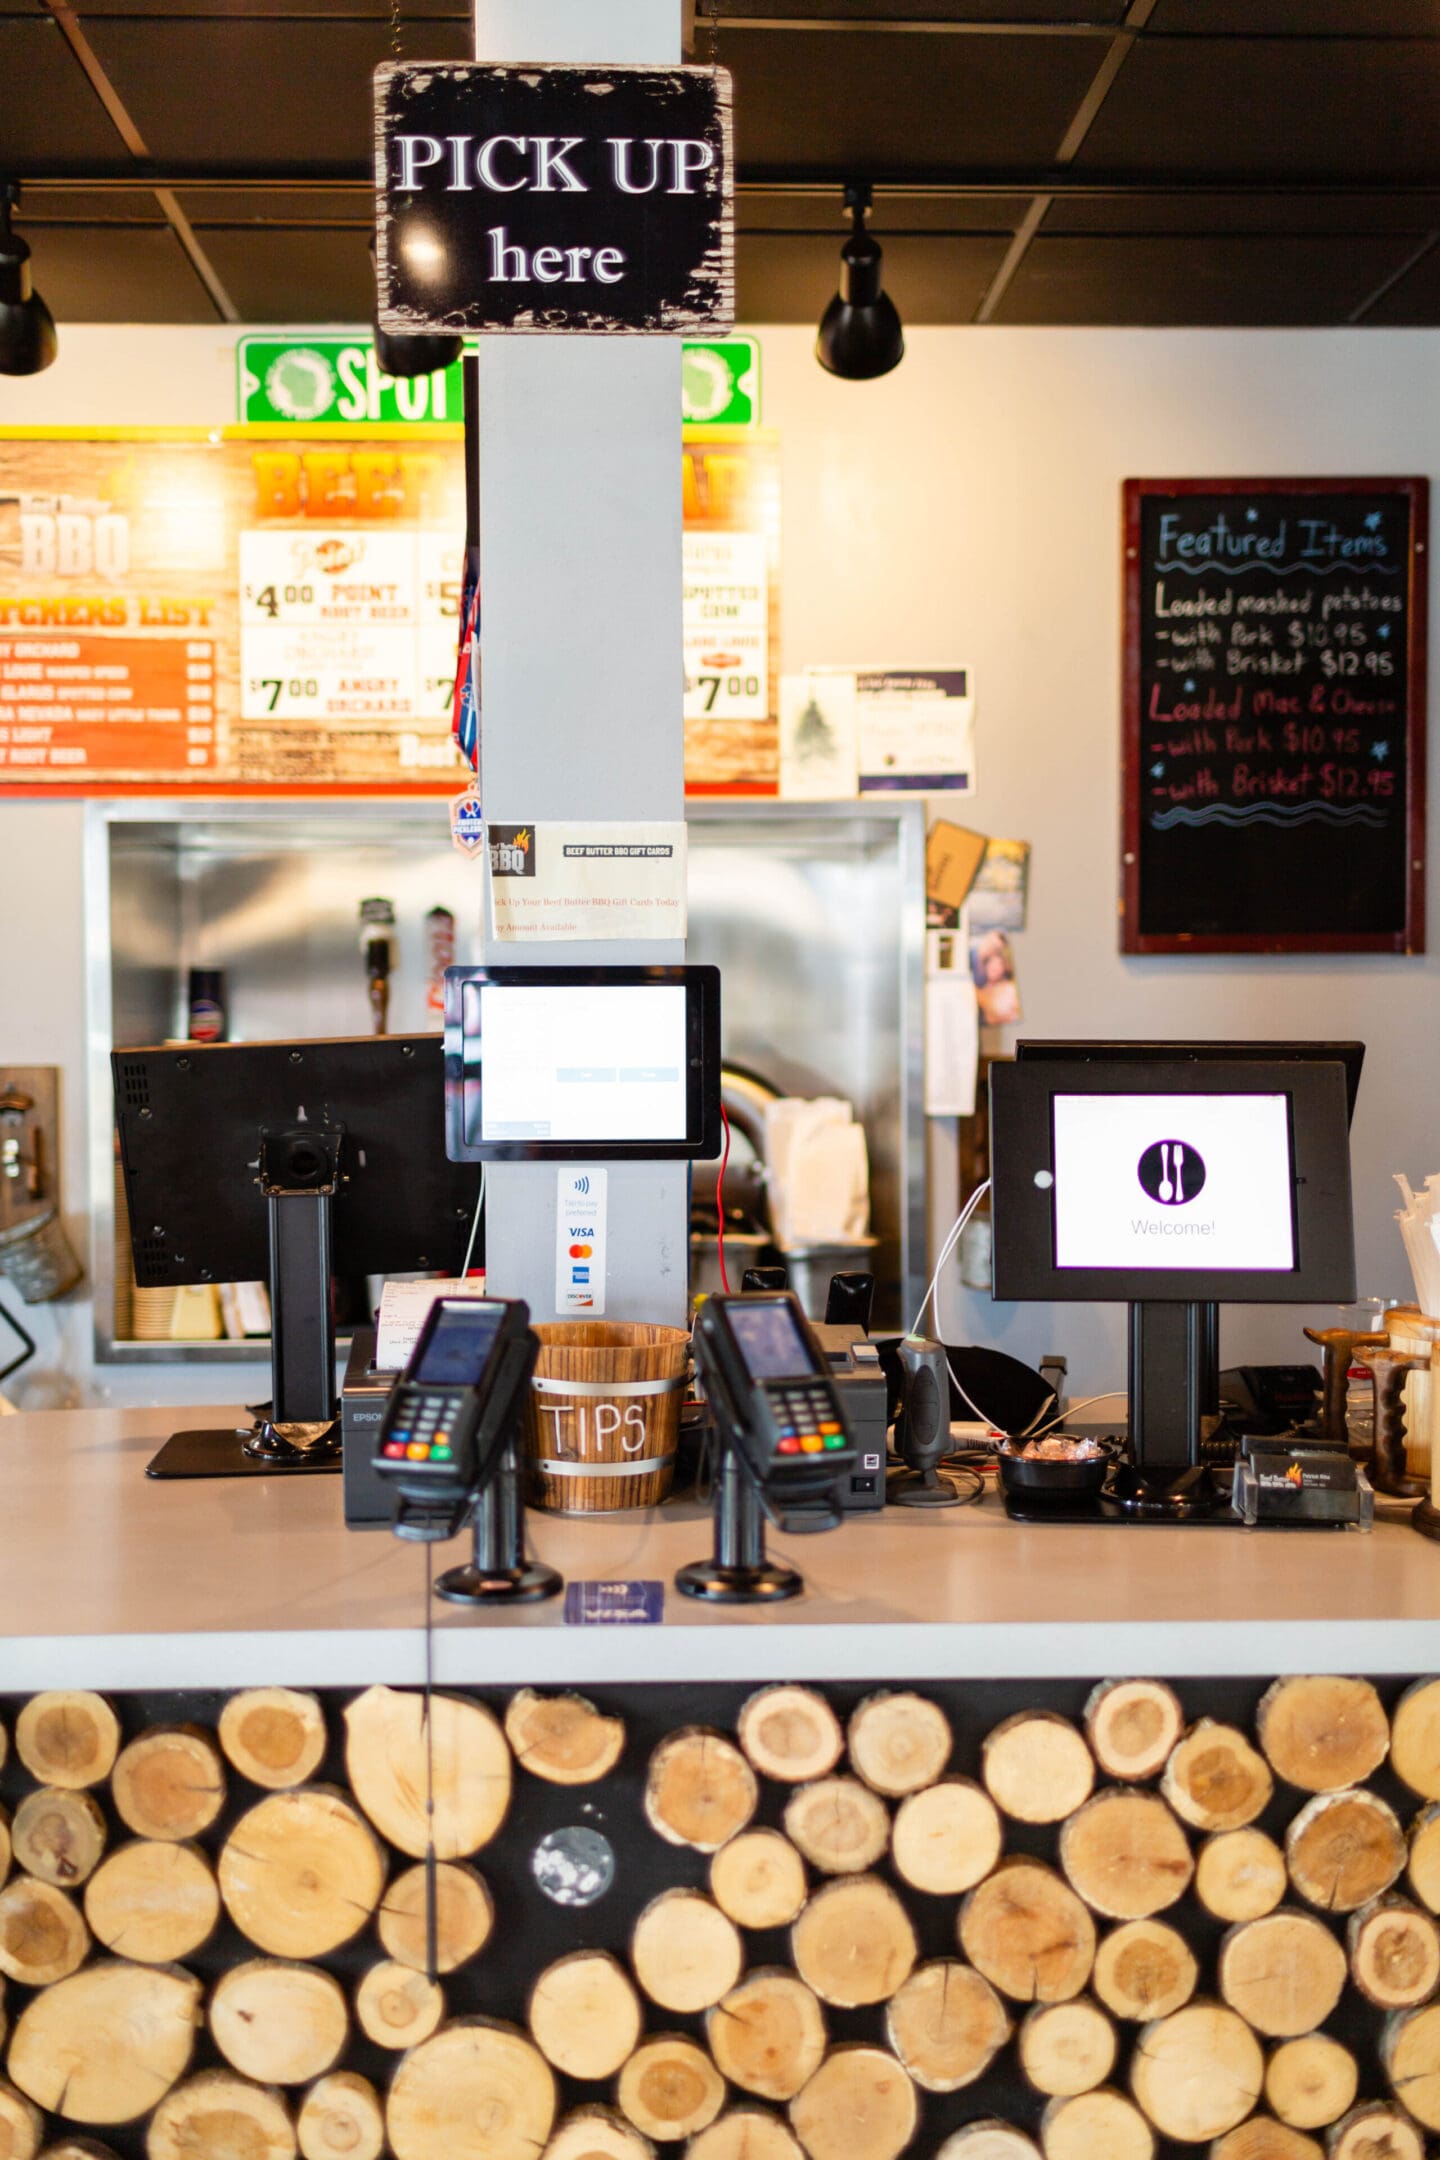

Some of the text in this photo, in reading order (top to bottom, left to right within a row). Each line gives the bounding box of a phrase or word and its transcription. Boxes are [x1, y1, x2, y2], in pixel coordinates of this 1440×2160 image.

[392, 135, 714, 194] PICK UP
[487, 226, 625, 283] here
[253, 452, 446, 517] BEER
[20, 514, 130, 586] BBQ
[1159, 512, 1387, 560] Featured Items
[138, 597, 216, 626] LIST
[1155, 580, 1402, 621] Loaded mashed potatoes
[1231, 621, 1273, 645] Pork
[1227, 649, 1305, 675] Brisket
[1149, 683, 1243, 721] Loaded
[1254, 689, 1301, 715] Mac
[1225, 726, 1273, 751] Pork
[1232, 763, 1314, 796] Brisket
[566, 847, 670, 855] BEEF BUTTER BBQ GIFT CARDS
[509, 898, 521, 907] Up
[522, 898, 540, 906] Your
[543, 897, 562, 906] Beef
[564, 897, 590, 906] Butter
[592, 898, 611, 907] BBQ
[612, 897, 628, 906] Gift
[630, 897, 653, 906] Cards
[656, 897, 679, 907] Today
[506, 923, 538, 931] Amount
[541, 923, 577, 931] Available
[569, 1228, 594, 1237] VISA
[1131, 1220, 1216, 1236] Welcome!
[540, 1404, 645, 1456] TIPS
